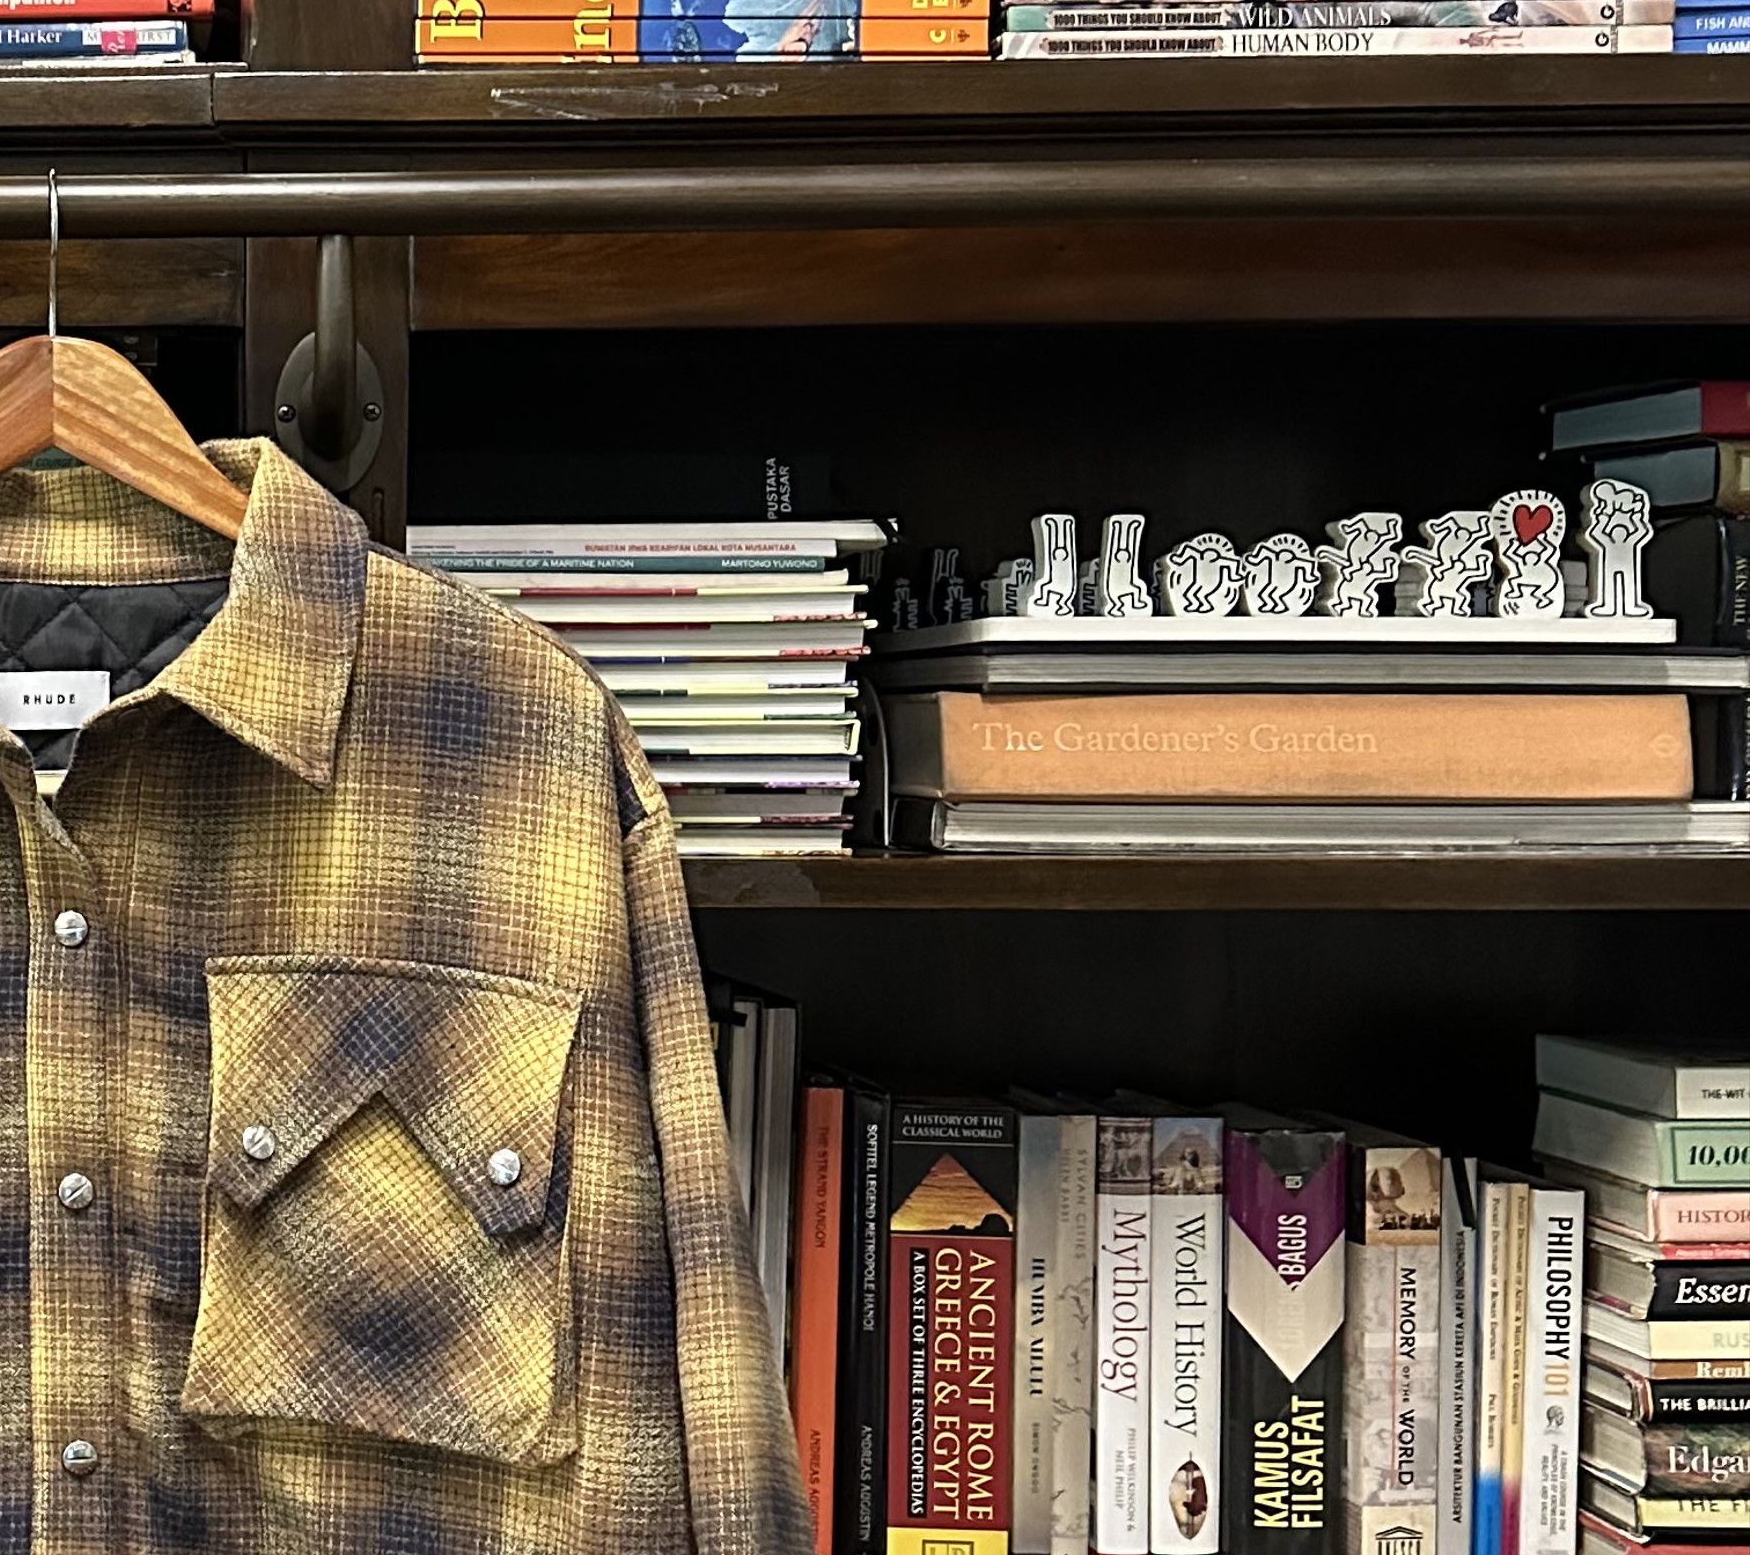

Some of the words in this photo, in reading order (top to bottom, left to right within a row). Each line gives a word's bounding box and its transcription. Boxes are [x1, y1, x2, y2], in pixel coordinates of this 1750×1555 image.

[7, 28, 62, 43] Harker
[1231, 33, 1311, 52] HUMAN
[1317, 32, 1375, 52] BODY
[767, 458, 778, 519] PUSTAKA
[780, 466, 791, 512] DASAR
[24, 694, 75, 704] RHUDE
[972, 722, 1045, 752] The
[1054, 722, 1239, 752] Gardener's
[1251, 722, 1377, 754] Garden
[1175, 1212, 1206, 1320] World
[1278, 1213, 1306, 1275] BAGUS
[934, 1248, 962, 1376] GREECE
[1100, 1209, 1148, 1403] Mythology
[1399, 1268, 1416, 1360] MEMORY
[1546, 1216, 1573, 1357] PHILOSOPHY
[967, 1250, 996, 1413] ANCIENT
[1403, 1366, 1410, 1379] OF
[1165, 1329, 1206, 1439] History
[1402, 1382, 1410, 1403] THE
[1545, 1362, 1569, 1397] 101
[932, 1412, 960, 1519] EGYPT
[966, 1424, 994, 1522] ROME
[1254, 1422, 1289, 1528] KAMUS
[1292, 1396, 1324, 1528] FILSAFAT
[1399, 1409, 1416, 1486] WORLD
